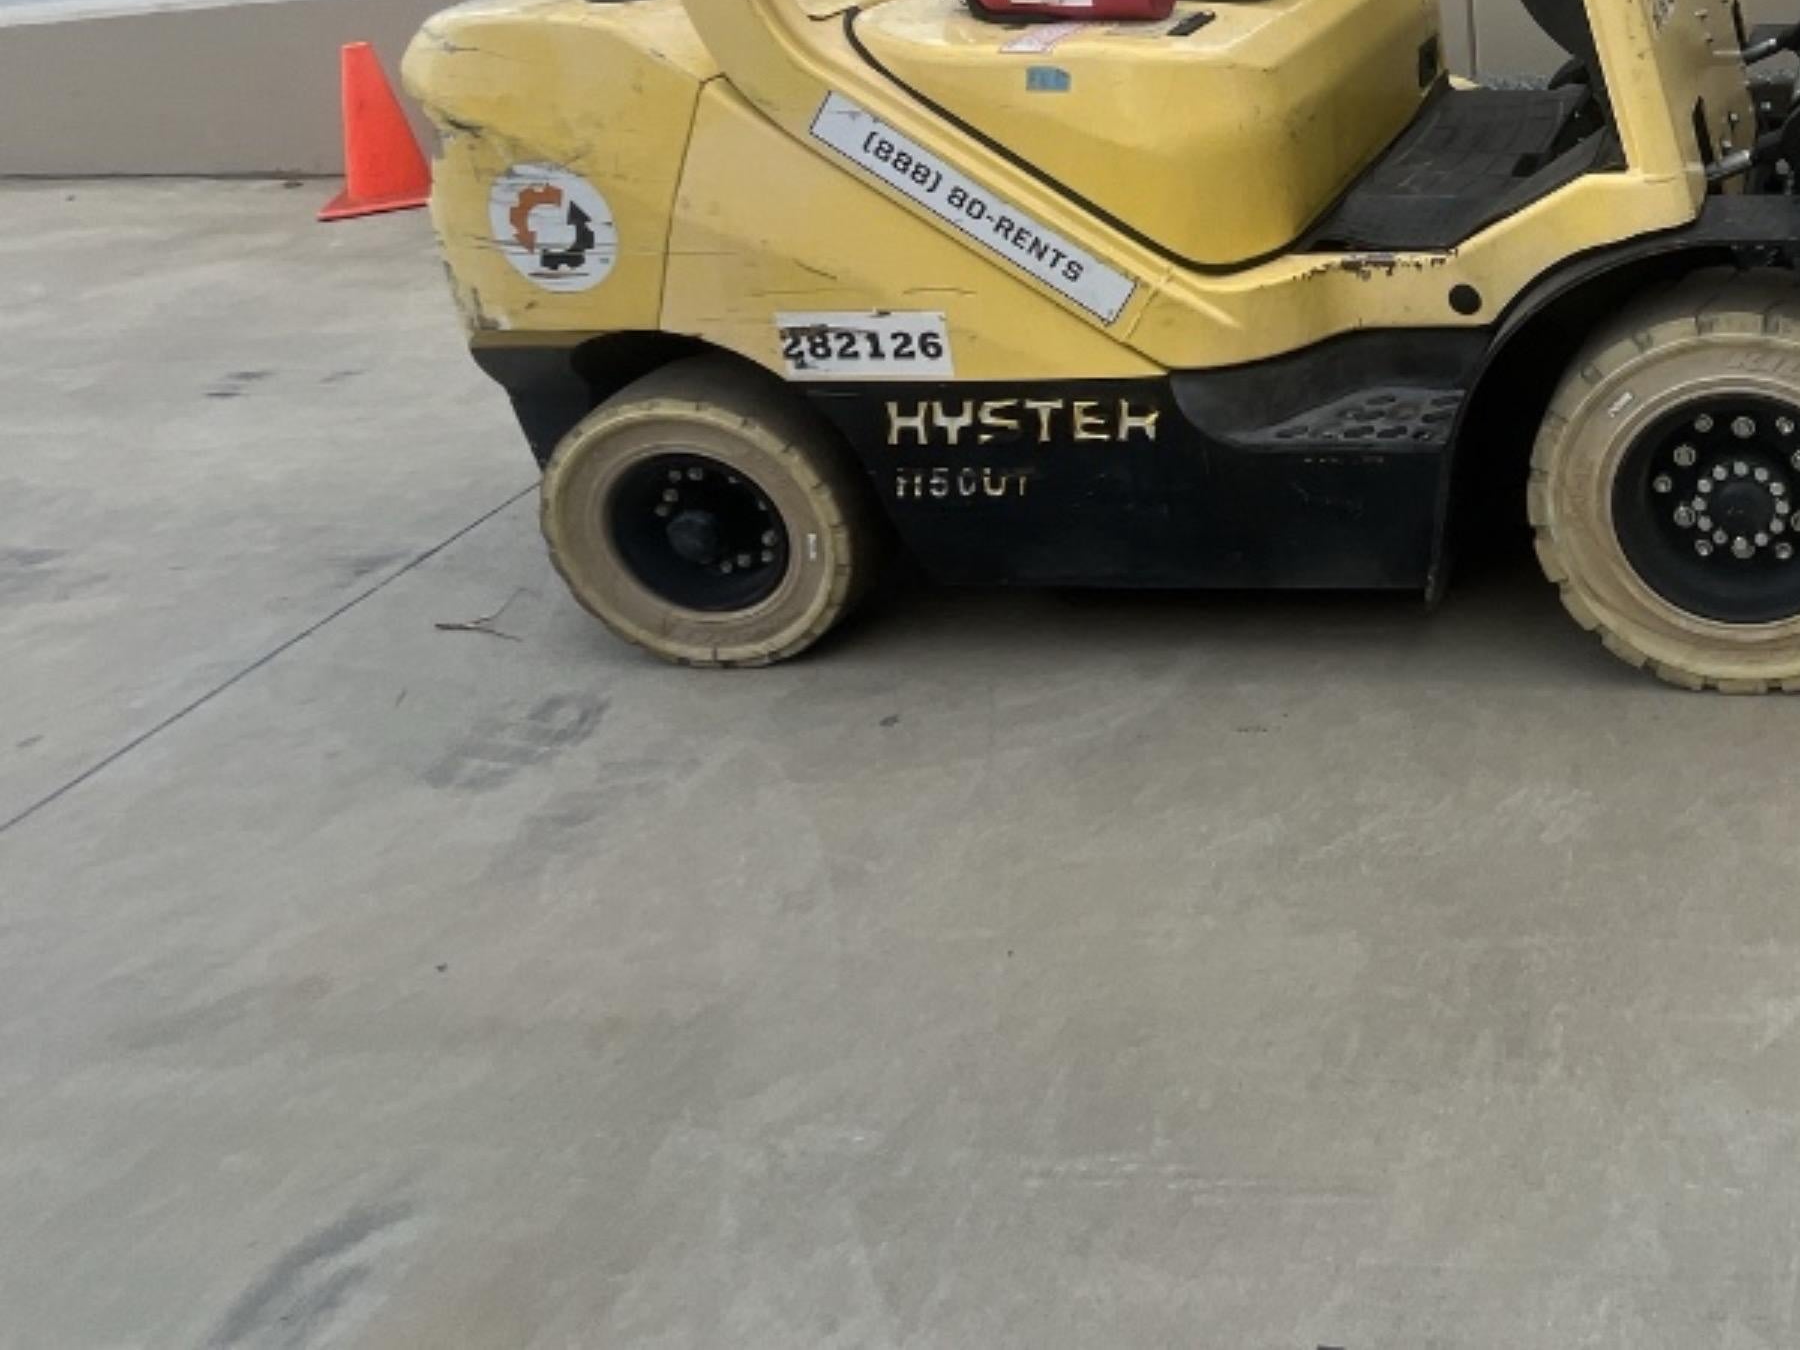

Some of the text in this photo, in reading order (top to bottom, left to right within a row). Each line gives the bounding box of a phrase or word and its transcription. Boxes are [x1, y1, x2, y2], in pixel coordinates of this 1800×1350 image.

[863, 131, 1085, 283] (888) 80-RENTS
[783, 330, 943, 360] 282126
